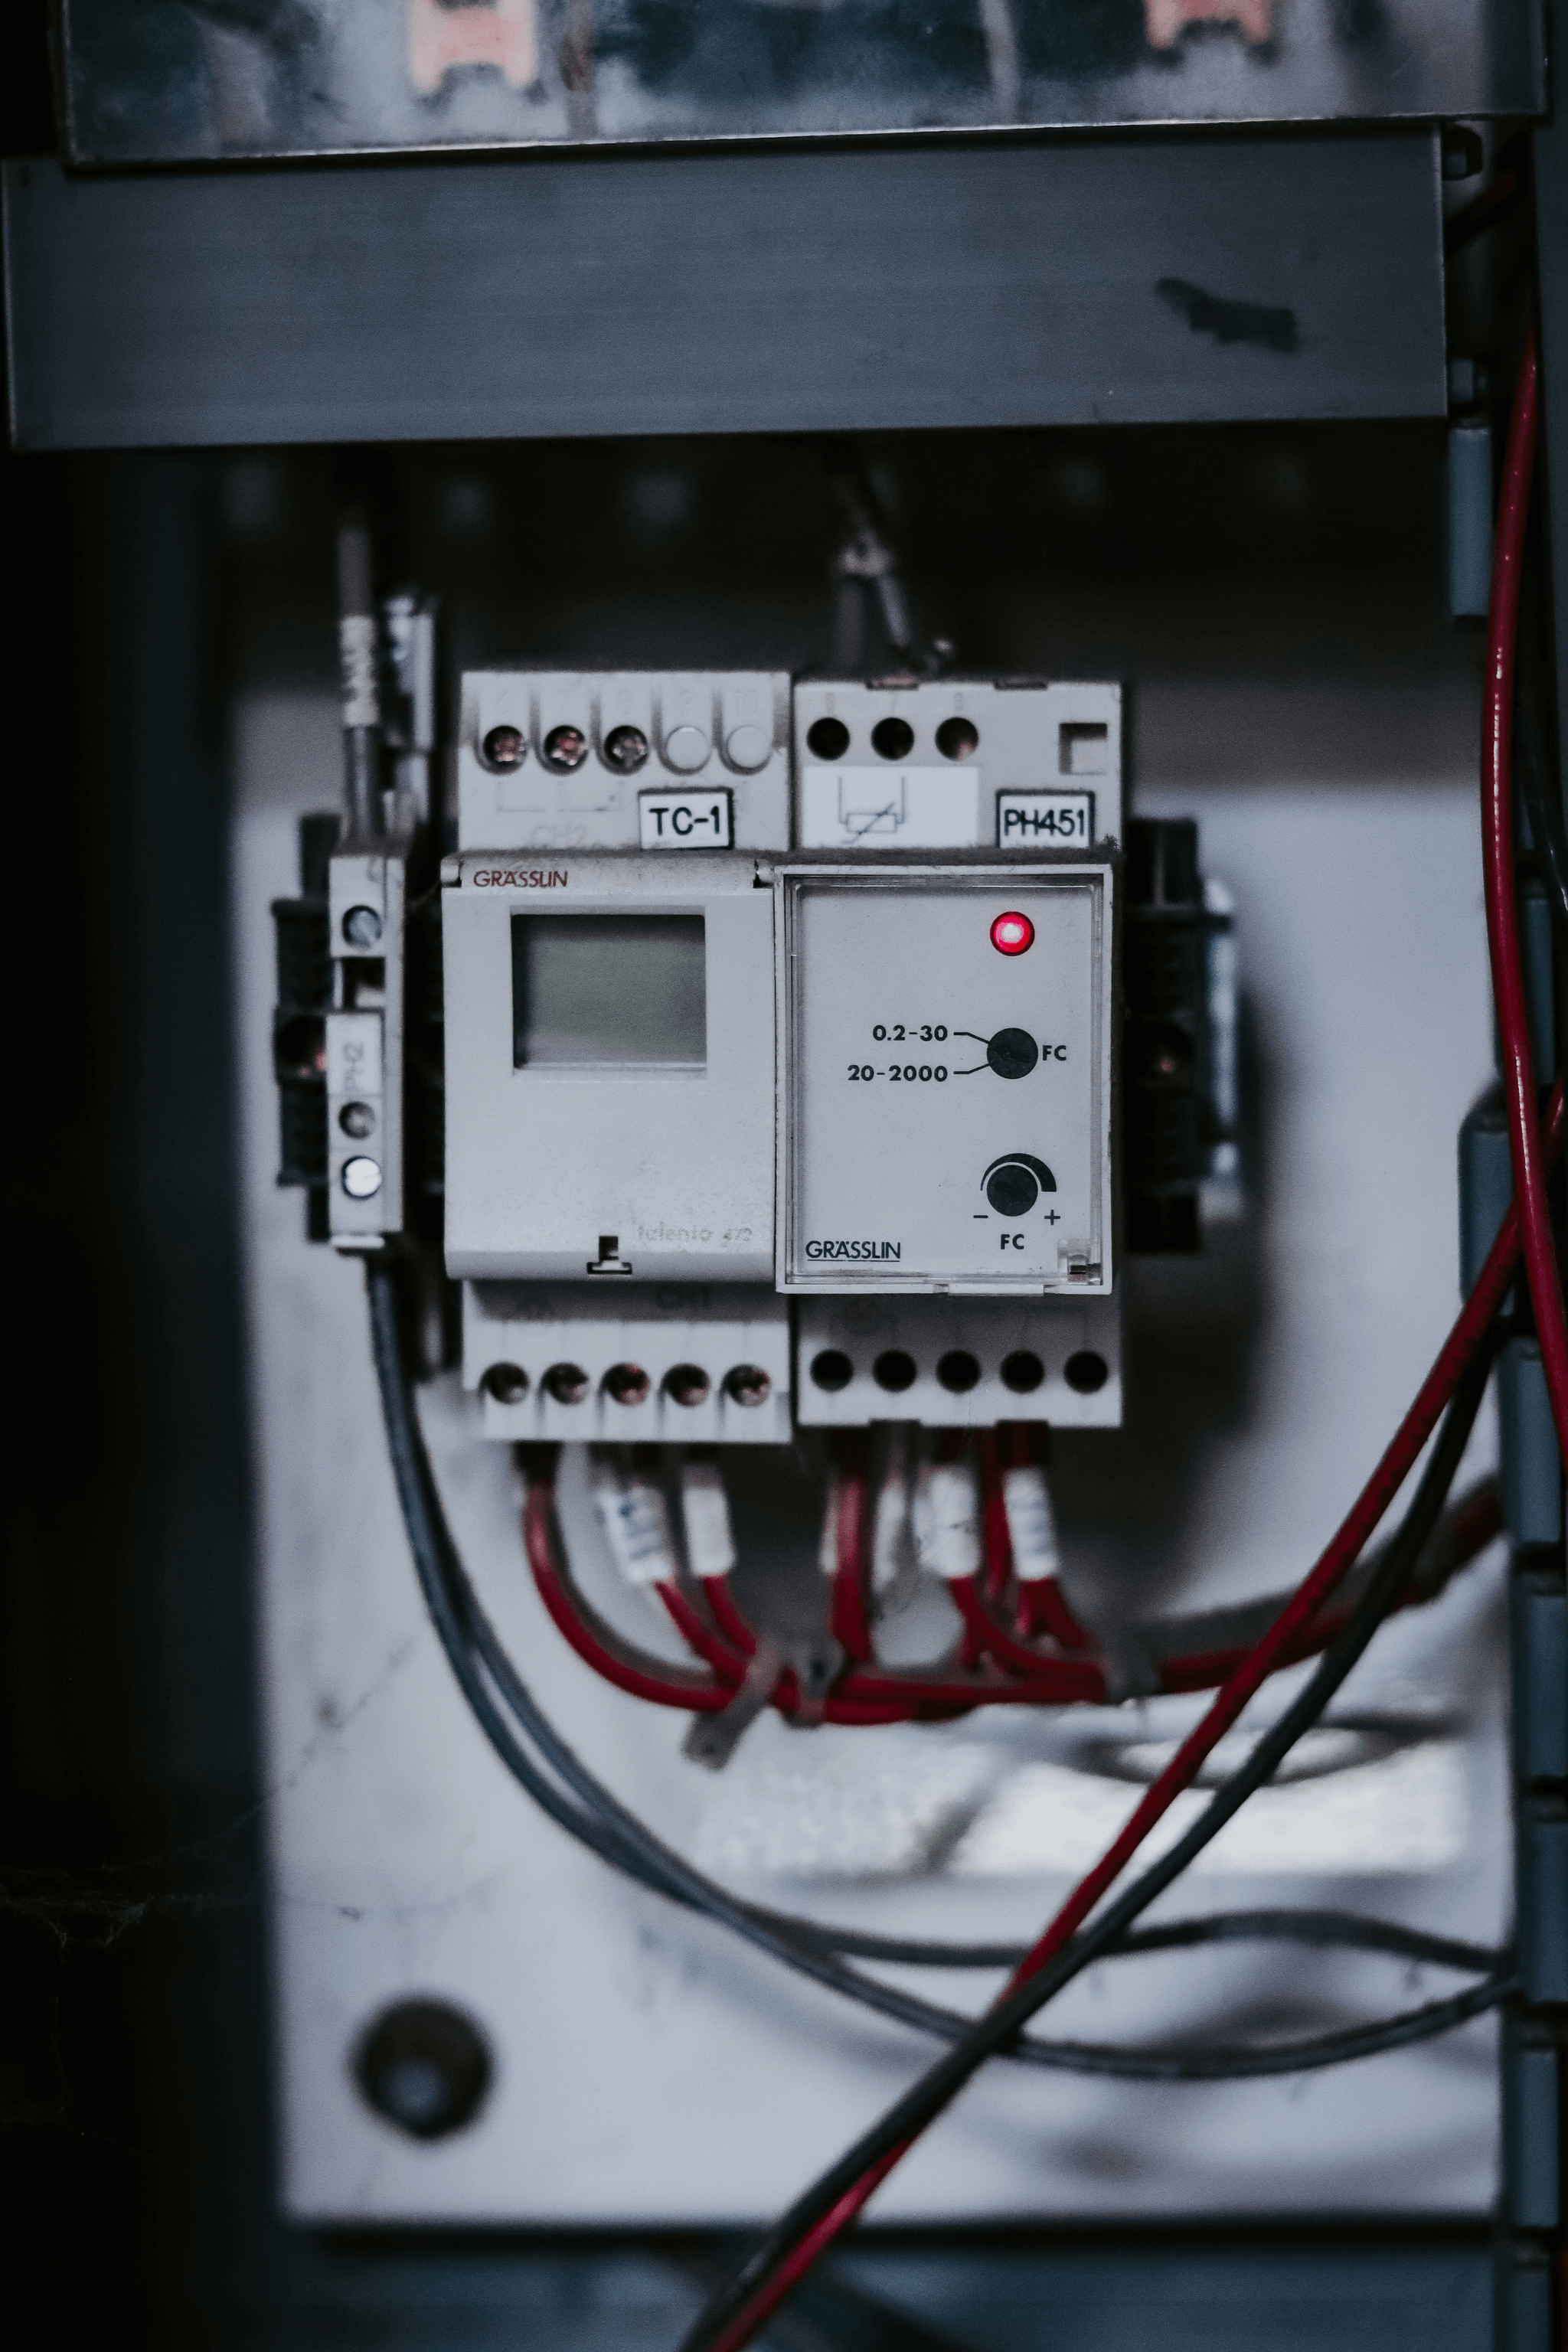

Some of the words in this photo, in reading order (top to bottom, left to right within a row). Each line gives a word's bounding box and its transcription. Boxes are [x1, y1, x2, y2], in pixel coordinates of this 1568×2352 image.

[648, 805, 720, 836] TC-1
[1004, 808, 1085, 837] PH451
[473, 870, 568, 888] GRÄSSLIN
[872, 1024, 948, 1042] 0.2-30
[1042, 1044, 1067, 1062] FC
[847, 1064, 949, 1083] 20-2000
[805, 1240, 901, 1259] GRÄSSLIN
[1000, 1233, 1025, 1250] FC
